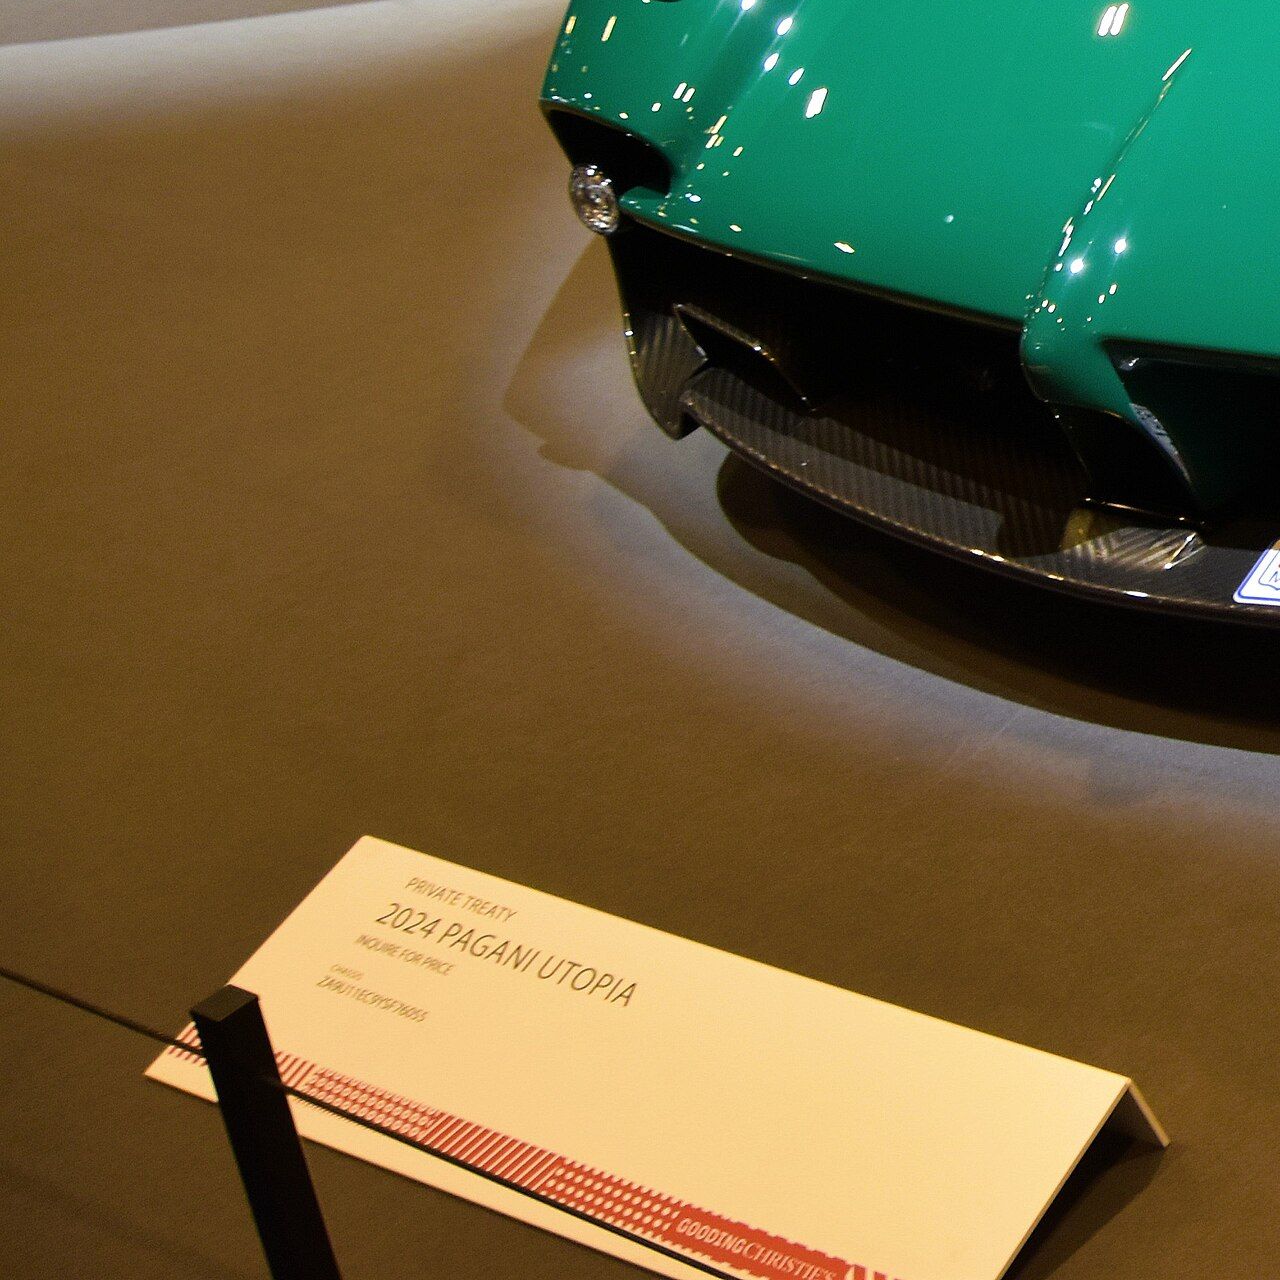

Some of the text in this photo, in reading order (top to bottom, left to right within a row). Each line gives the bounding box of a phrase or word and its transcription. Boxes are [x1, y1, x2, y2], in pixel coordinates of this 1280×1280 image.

[405, 876, 518, 923] PRIVATE TREATY
[375, 902, 638, 1008] 2024 PAGANI UTOPIA
[399, 947, 427, 965] FOR
[421, 955, 457, 978] PRICE
